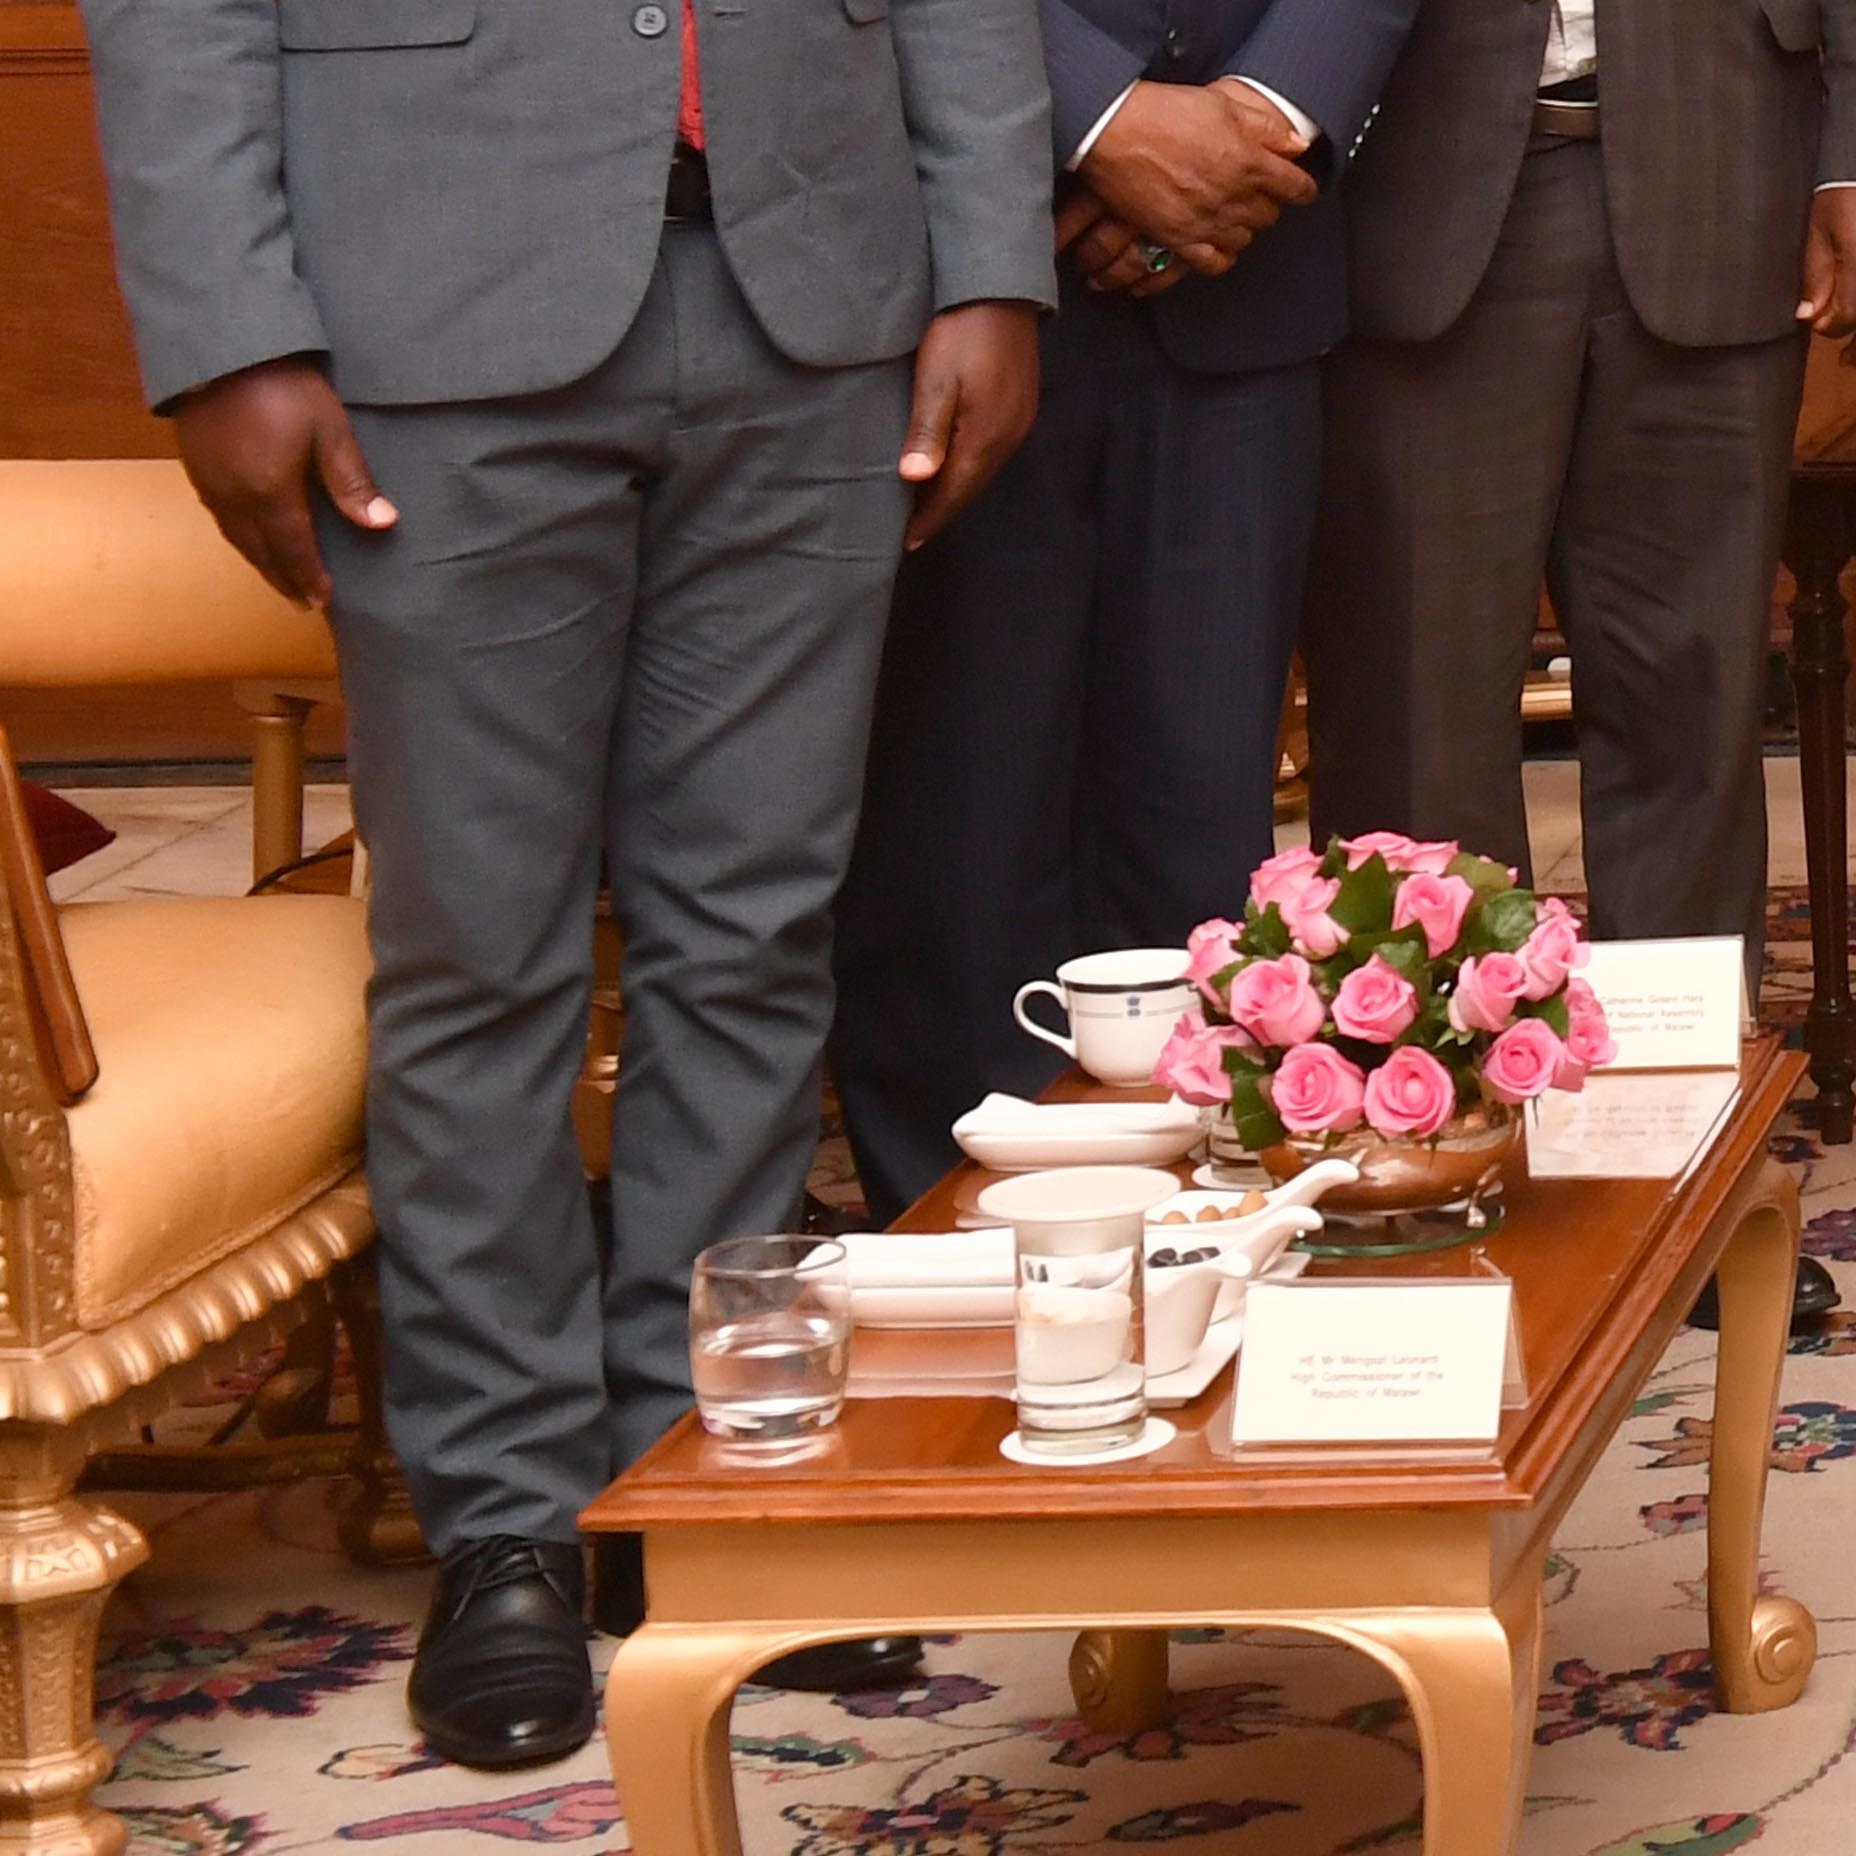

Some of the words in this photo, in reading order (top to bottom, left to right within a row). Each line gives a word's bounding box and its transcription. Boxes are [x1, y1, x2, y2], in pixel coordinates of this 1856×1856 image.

[1322, 1372, 1405, 1382] Commissioner
[1410, 1370, 1422, 1380] of
[1312, 1388, 1360, 1399] Republic
